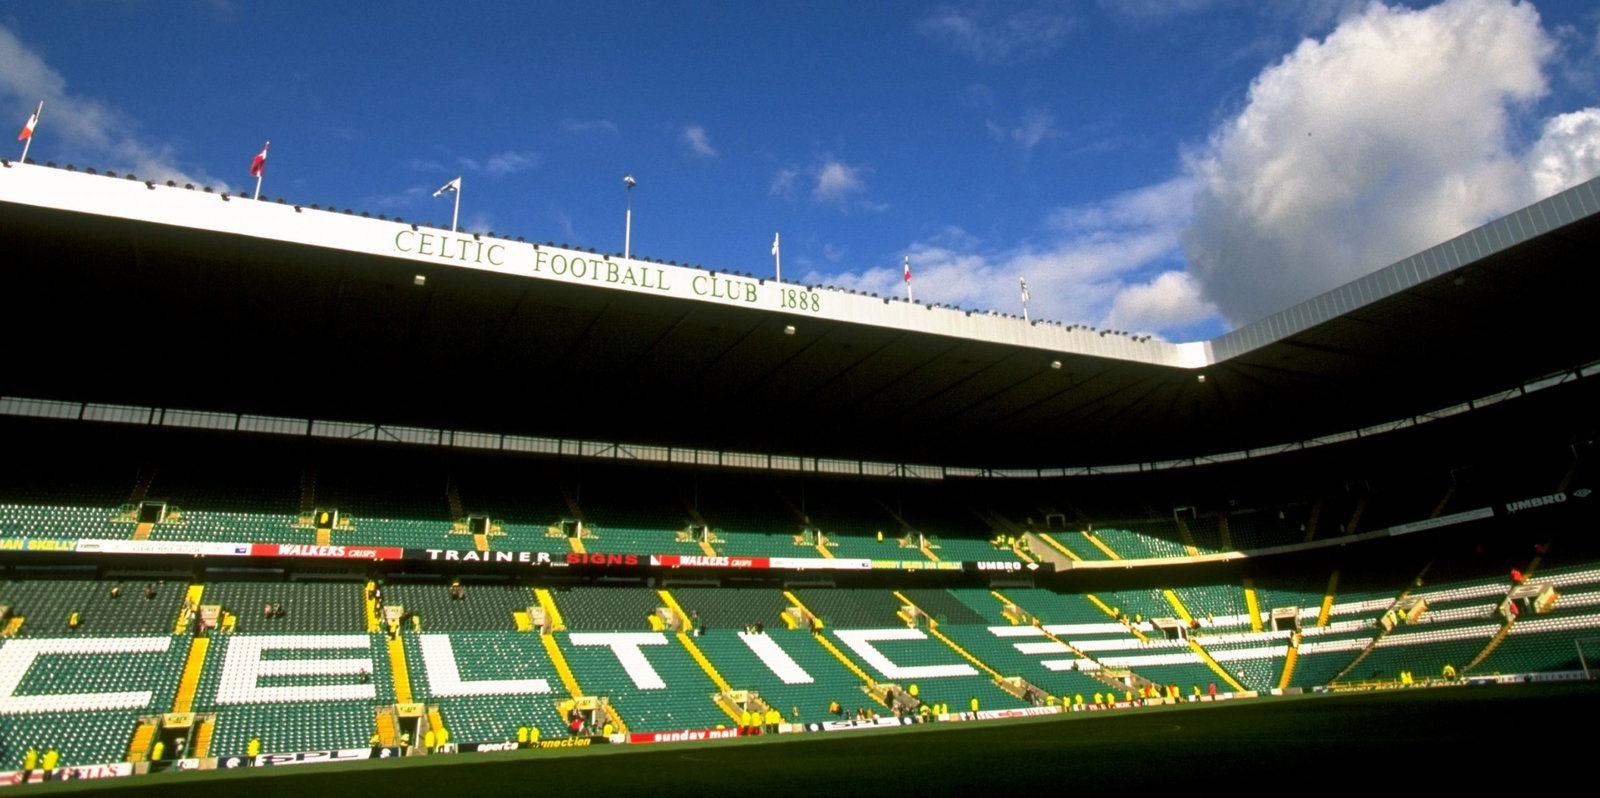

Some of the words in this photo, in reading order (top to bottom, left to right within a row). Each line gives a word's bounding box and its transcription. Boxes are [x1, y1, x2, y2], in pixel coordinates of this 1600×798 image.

[394, 230, 506, 265] CELTIC
[533, 250, 671, 291] FOOTBALL
[692, 275, 758, 303] CLUB
[779, 288, 821, 313] 1888
[1506, 492, 1567, 512] UMBRO
[28, 540, 77, 551] SKELLY
[278, 544, 346, 558] WALKERS
[348, 549, 376, 559] CRISPS
[426, 549, 550, 563] TRAINER
[566, 553, 639, 565] SIGNS
[680, 555, 729, 568] WALKERS
[977, 561, 1022, 571] UMBRO
[0, 628, 980, 713] CELTIC
[654, 730, 706, 742] sunday
[709, 728, 738, 738] mail
[530, 737, 591, 750] nnection
[257, 751, 360, 766] SPL
